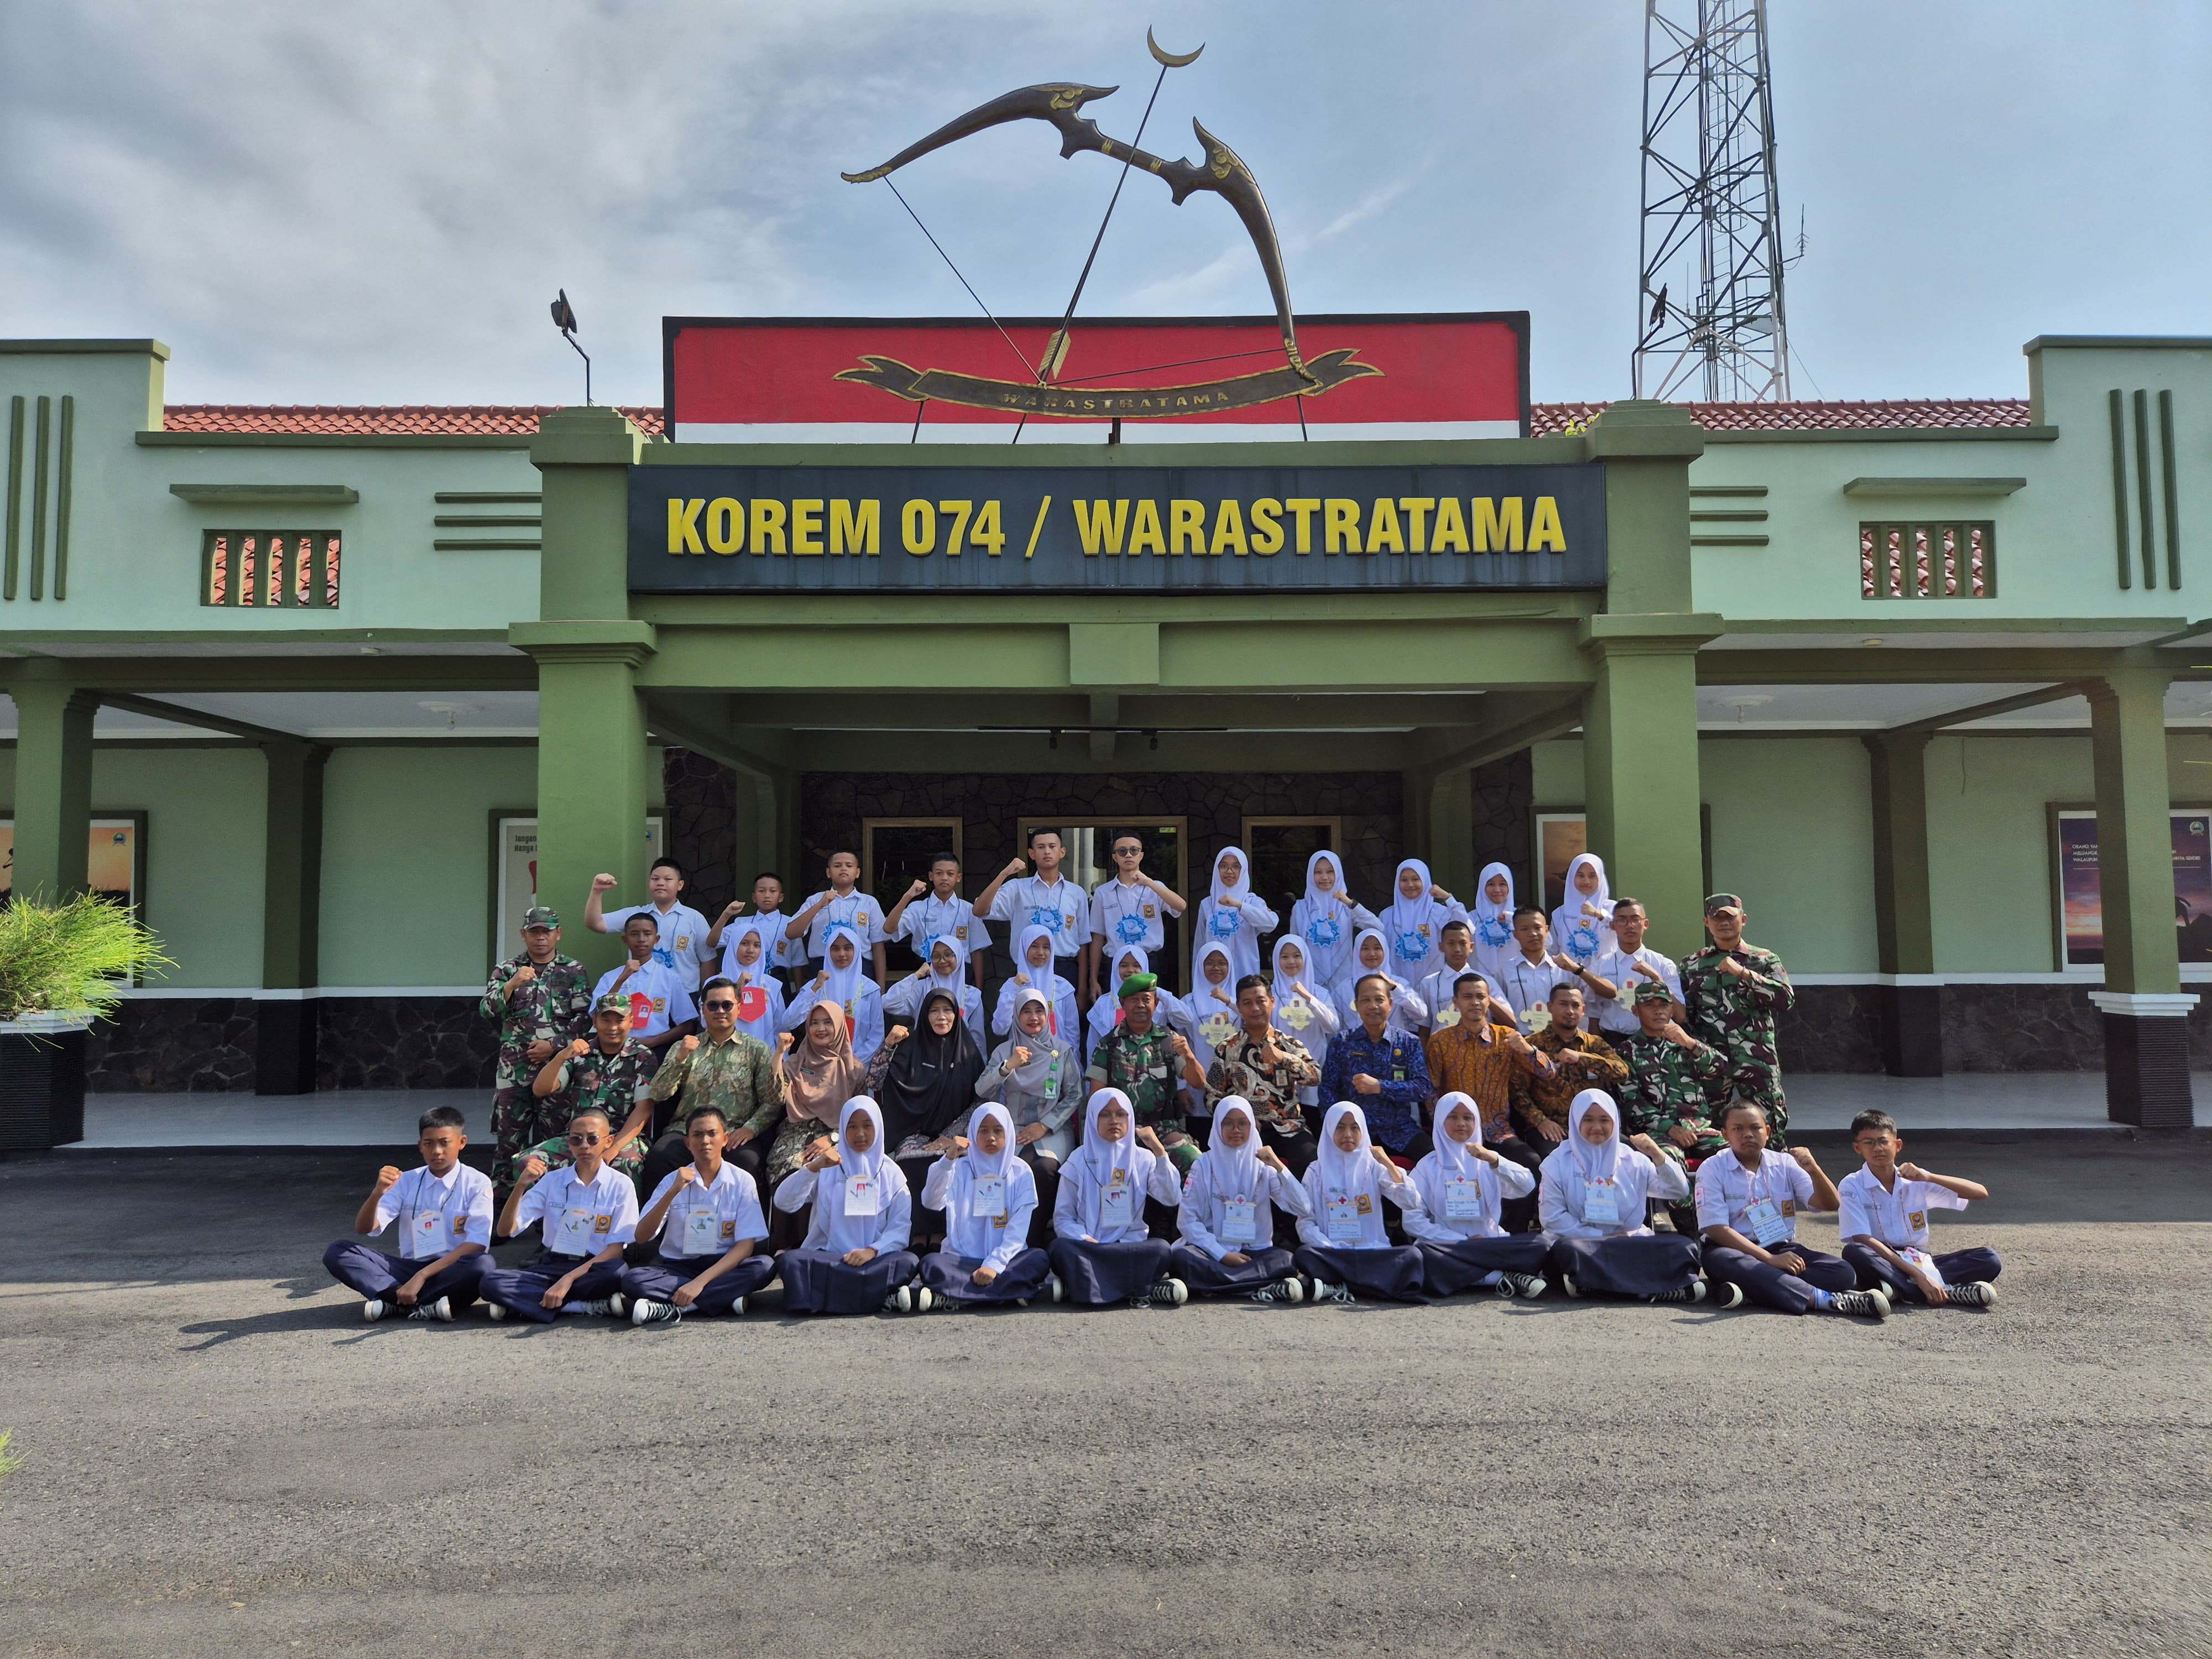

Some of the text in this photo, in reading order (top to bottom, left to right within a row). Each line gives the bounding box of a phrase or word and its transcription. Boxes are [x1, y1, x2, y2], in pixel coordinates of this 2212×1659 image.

[1003, 391, 1229, 410] WARASTRATAMA
[667, 495, 1567, 559] KOREM 074 / WARASTRATAMA
